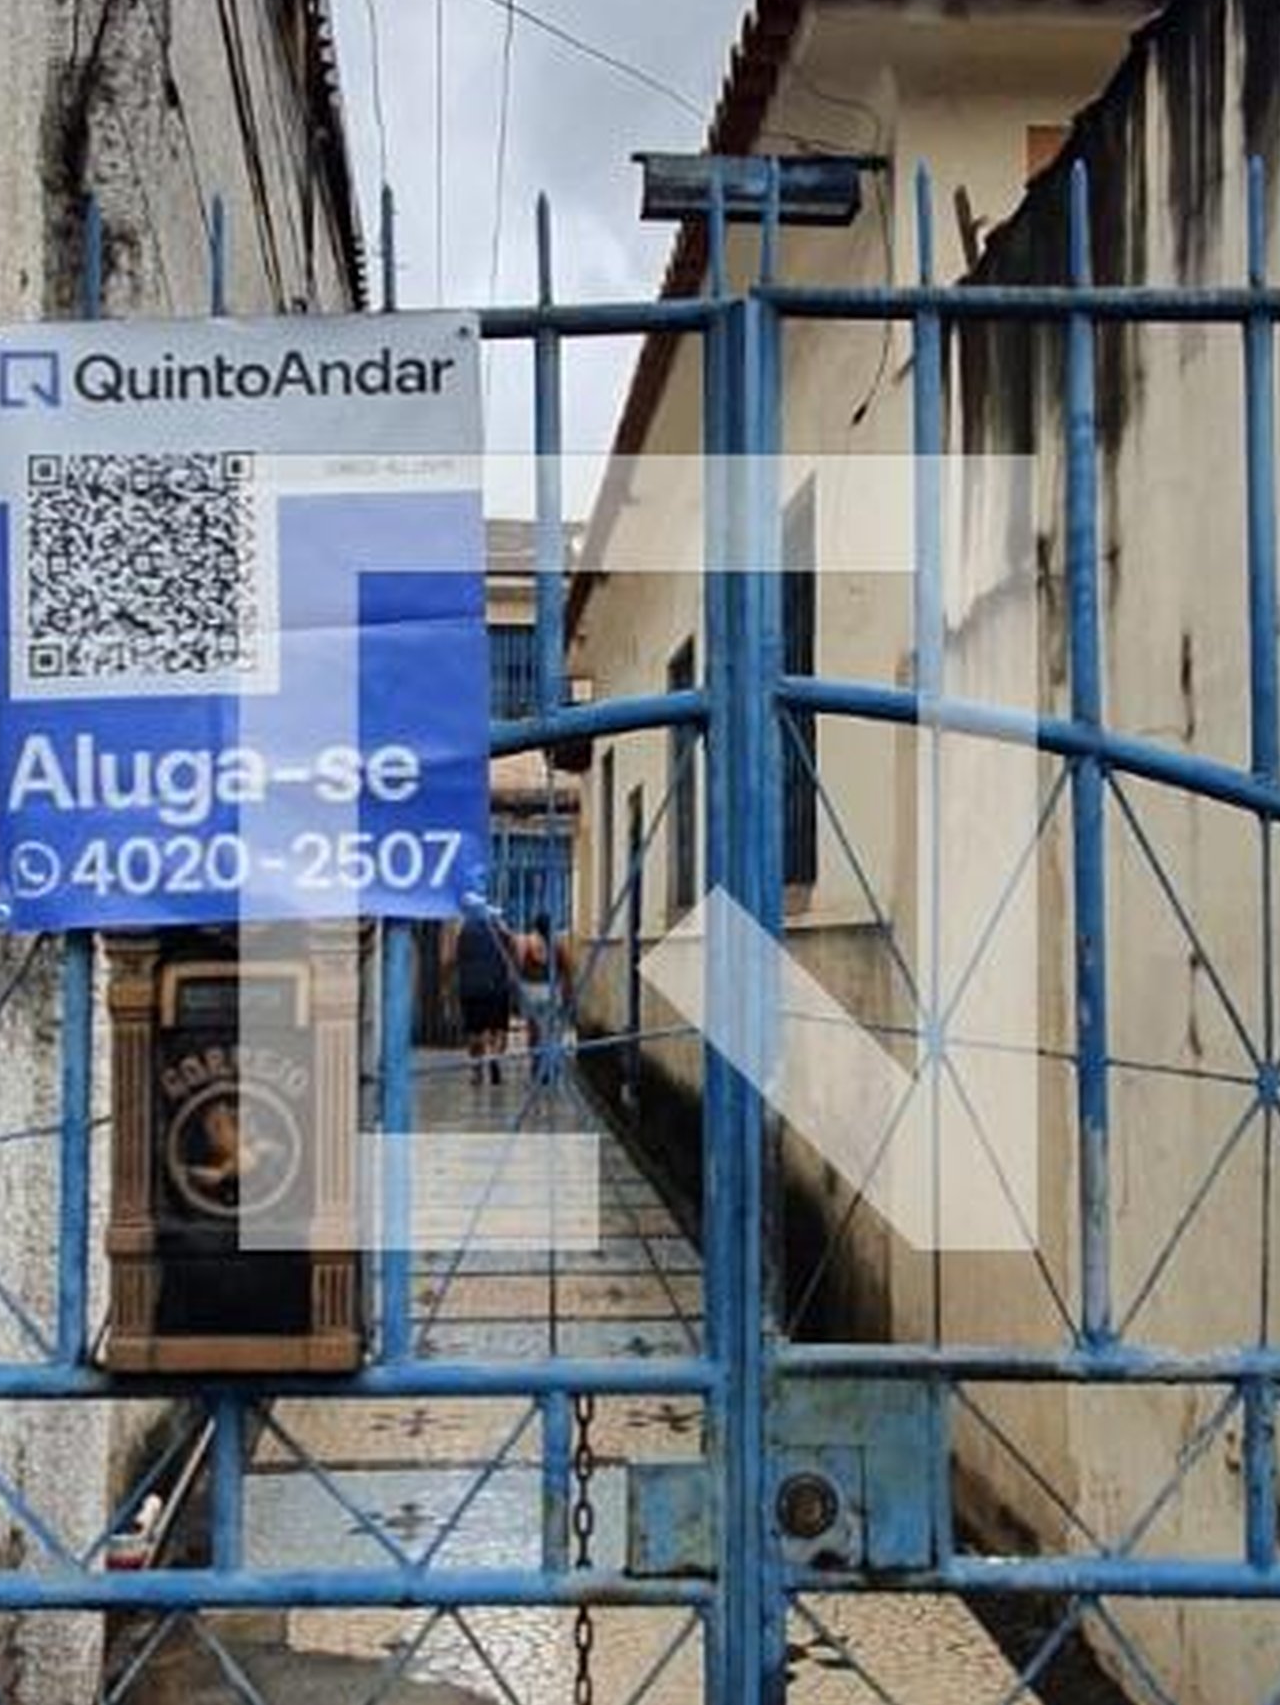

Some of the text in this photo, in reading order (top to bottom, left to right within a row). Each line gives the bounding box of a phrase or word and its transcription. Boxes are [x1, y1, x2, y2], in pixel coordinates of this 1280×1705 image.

[73, 349, 454, 403] QuintoAndar
[7, 733, 421, 826] Aluga-se
[71, 829, 463, 894] 4020-2507
[159, 1043, 310, 1101] CORREIO
